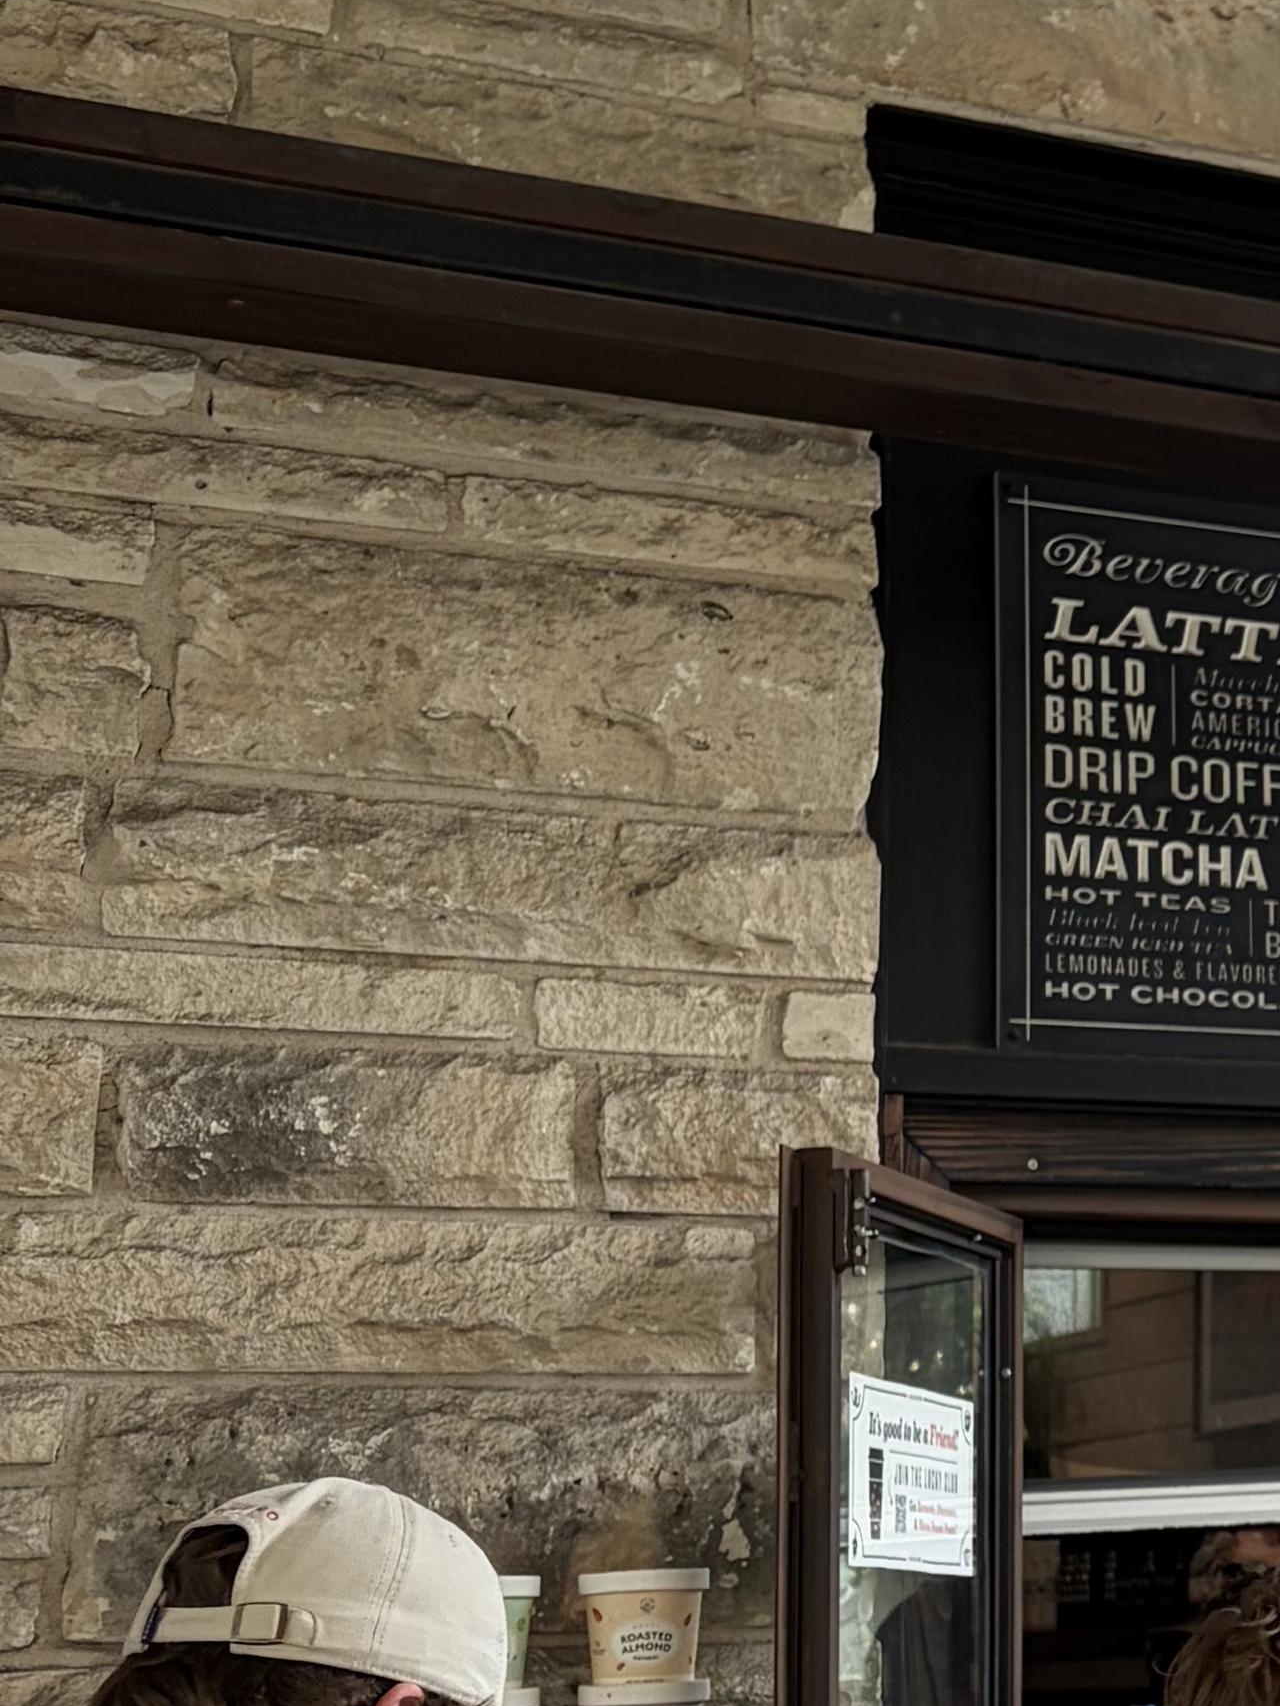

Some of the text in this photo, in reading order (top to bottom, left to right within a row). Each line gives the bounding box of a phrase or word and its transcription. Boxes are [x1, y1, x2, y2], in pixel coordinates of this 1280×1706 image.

[1044, 650, 1146, 696] COLD
[1044, 695, 1156, 742] BREW
[1044, 742, 1155, 794] DRIP
[1044, 797, 1172, 832] CHAI
[1044, 832, 1268, 891] MATCHA
[1045, 886, 1231, 914] HOT TEAS
[1045, 933, 1124, 950] GREEN
[1045, 952, 1164, 980] LEMONADES
[1173, 959, 1186, 981] &
[1045, 980, 1120, 1002] HOT
[883, 1417, 902, 1443] good
[620, 1631, 672, 1644] ROASTED
[621, 1642, 671, 1654] ALMOND
